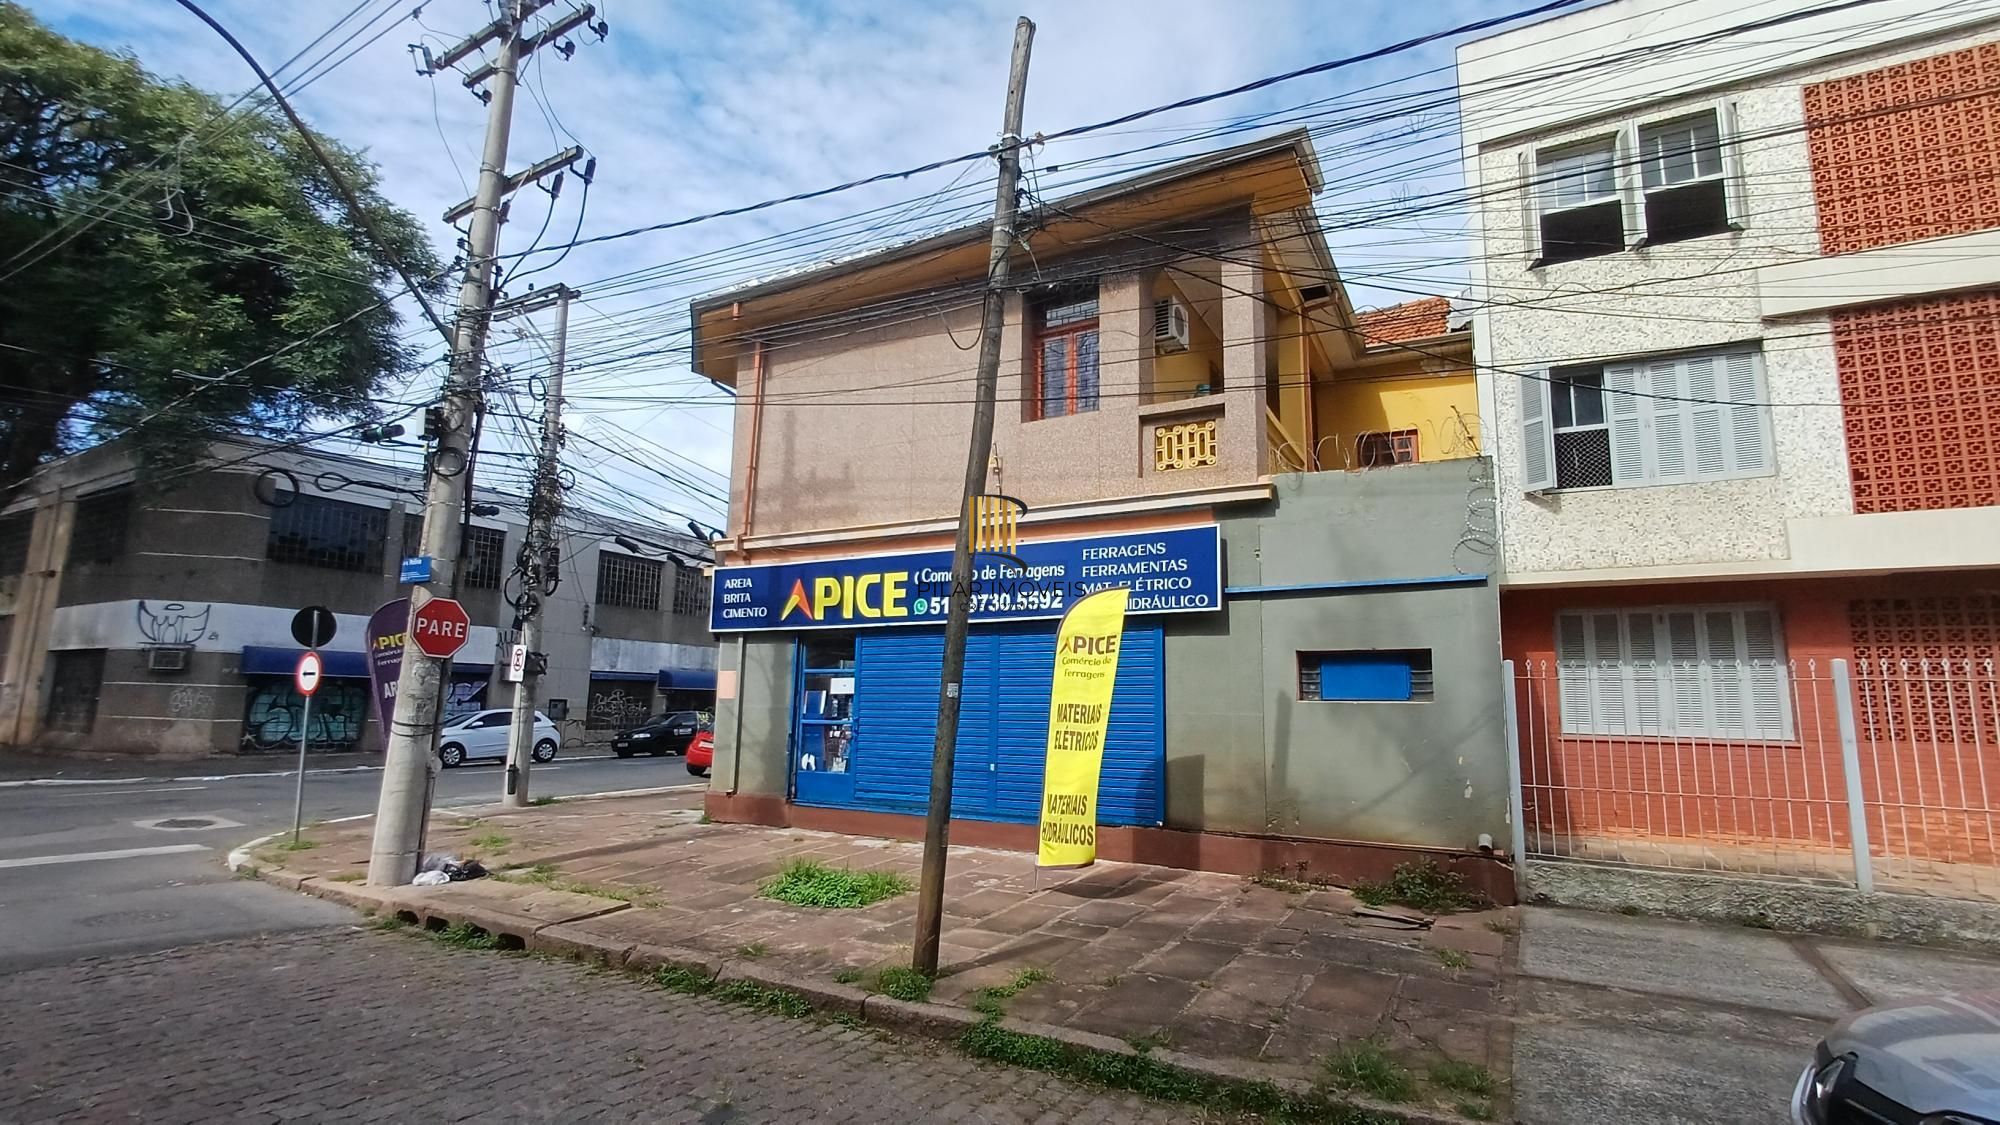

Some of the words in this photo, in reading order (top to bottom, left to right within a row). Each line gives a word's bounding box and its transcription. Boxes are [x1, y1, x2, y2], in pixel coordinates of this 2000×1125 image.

[1082, 542, 1166, 560] FERRAGENS
[981, 565, 996, 580] de
[999, 564, 1065, 582] Ferragens
[1082, 559, 1188, 577] FERRAMENTAS
[724, 578, 752, 589] AREIA
[724, 593, 751, 604] BRITA
[780, 571, 909, 621] APICE
[723, 607, 767, 619] CIMENTO
[416, 617, 466, 638] PARE
[1059, 634, 1117, 655] APICE
[1062, 656, 1101, 666] Comércio
[1102, 656, 1112, 664] de
[1056, 703, 1102, 725] MATERIAIS
[1054, 726, 1099, 751] ELÉTRICOS
[1042, 818, 1094, 846] HIDRÁULICOS
